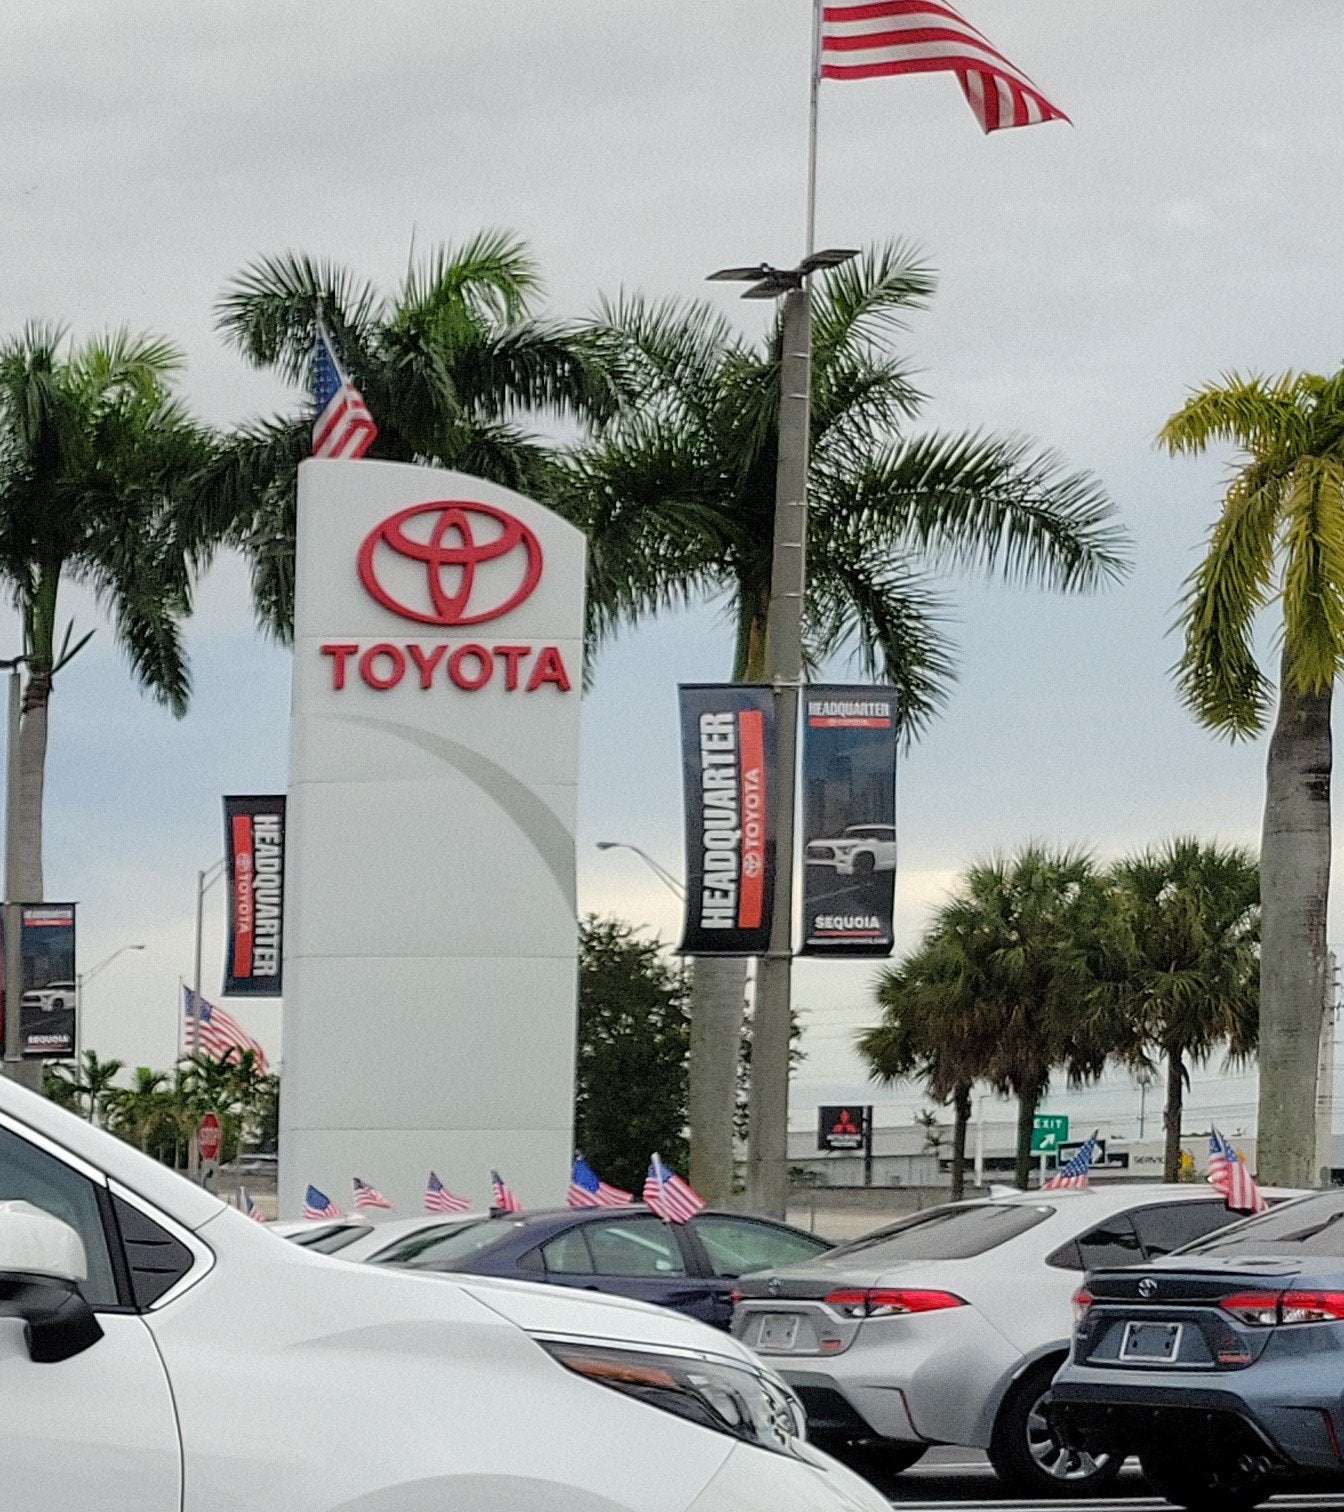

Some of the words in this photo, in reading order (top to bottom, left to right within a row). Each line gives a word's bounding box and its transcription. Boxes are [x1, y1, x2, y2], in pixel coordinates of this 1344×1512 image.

[319, 643, 571, 692] TOYOTA
[809, 701, 890, 718] HEADQUARTER
[699, 710, 741, 929] HEADQUARTER
[743, 769, 762, 849] TOYOTA
[235, 874, 252, 933] TOYOTA
[252, 814, 282, 976] HEADQUARTER
[814, 915, 880, 930] SEQUOIA
[1034, 1119, 1062, 1129] EXIT
